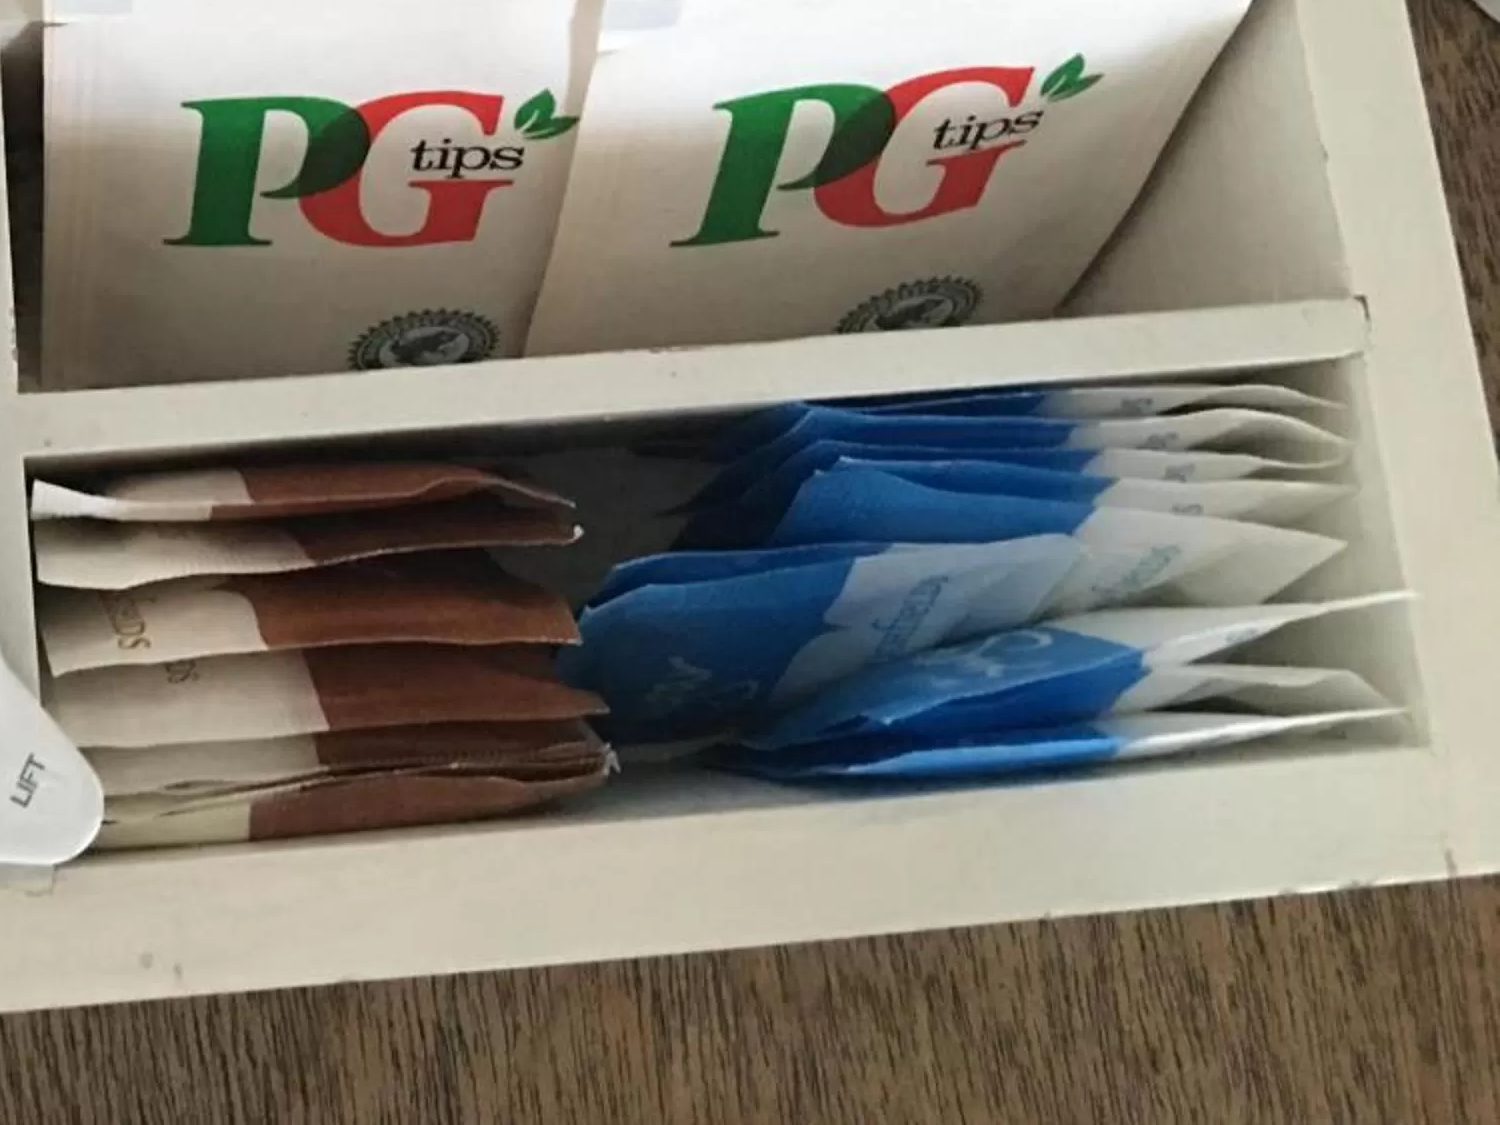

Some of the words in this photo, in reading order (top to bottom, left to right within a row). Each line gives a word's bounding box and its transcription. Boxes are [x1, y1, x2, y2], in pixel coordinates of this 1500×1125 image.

[162, 87, 515, 248] PG
[411, 135, 525, 178] tips
[670, 65, 1036, 248] PG
[931, 103, 1046, 155] tips
[9, 753, 46, 809] LIFT
